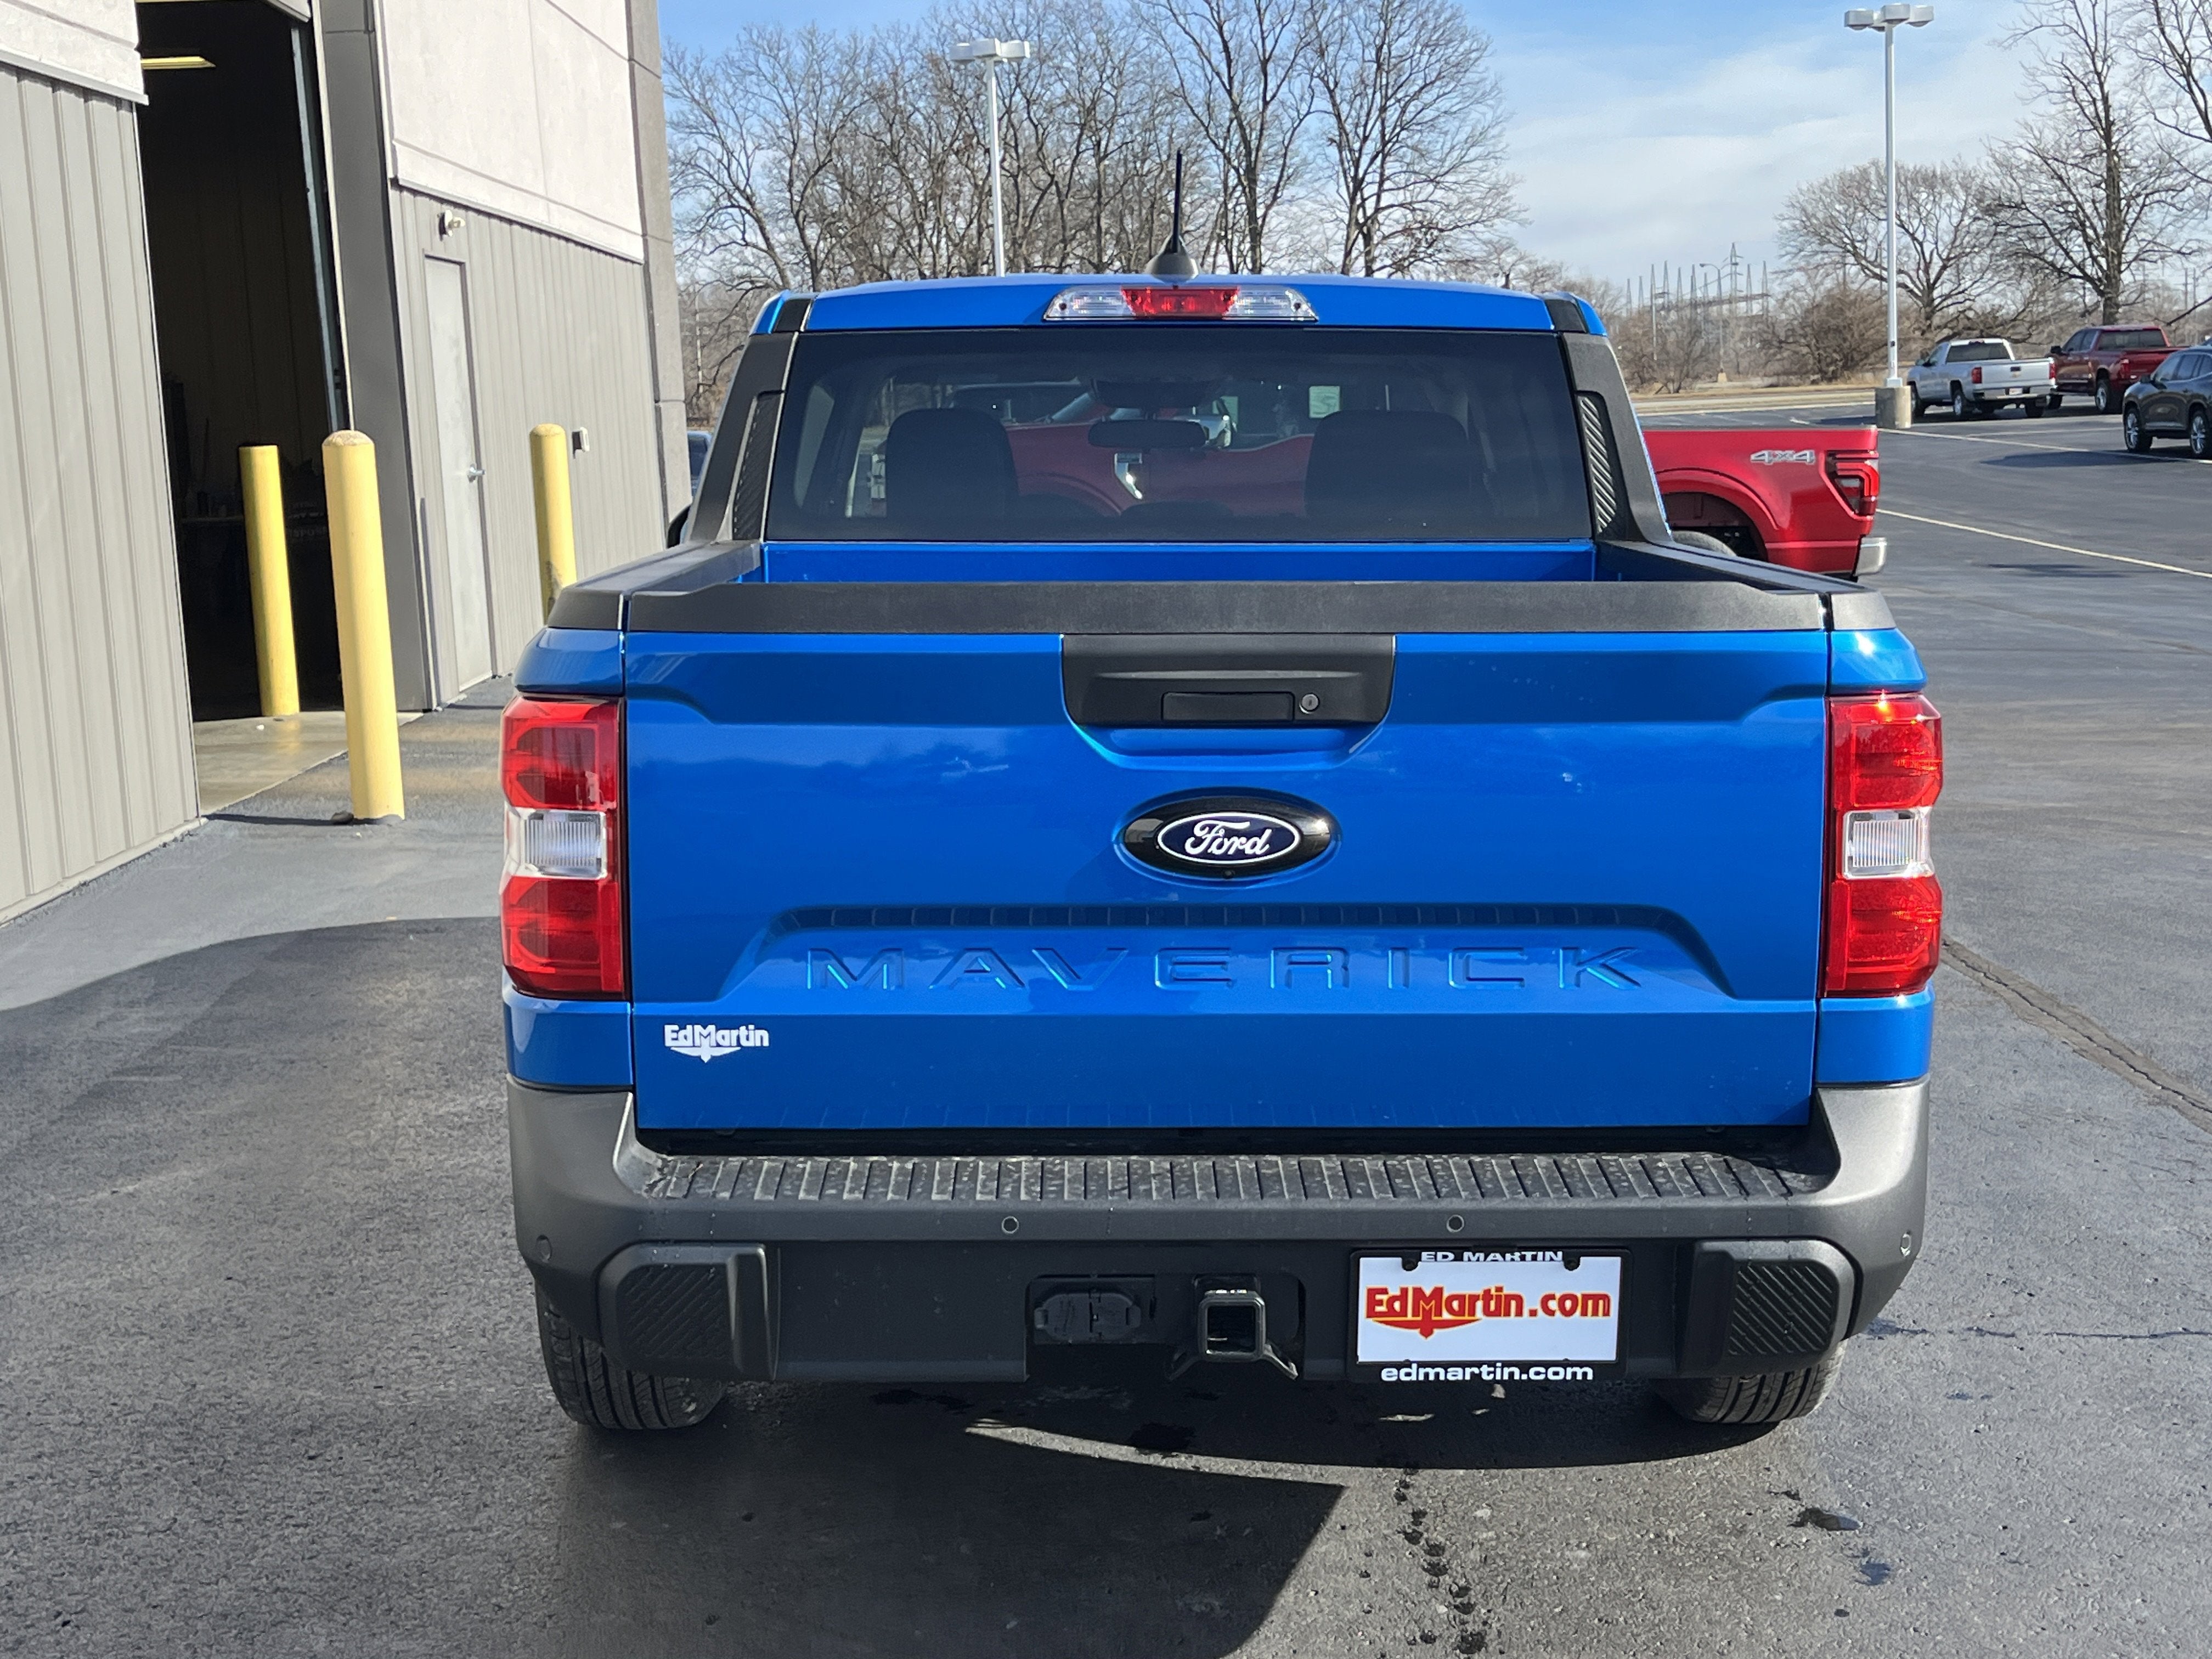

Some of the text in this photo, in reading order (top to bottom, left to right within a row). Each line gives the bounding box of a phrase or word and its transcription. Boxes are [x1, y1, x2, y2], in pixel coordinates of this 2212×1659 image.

[1184, 819, 1273, 855] Ford
[806, 947, 1642, 989] MAVERICK
[664, 1024, 769, 1047] EdMartin
[1420, 1251, 1563, 1262] ED MARTIN
[1365, 1285, 1612, 1319] EdMartin.com
[1380, 1363, 1594, 1381] edmartin.com
